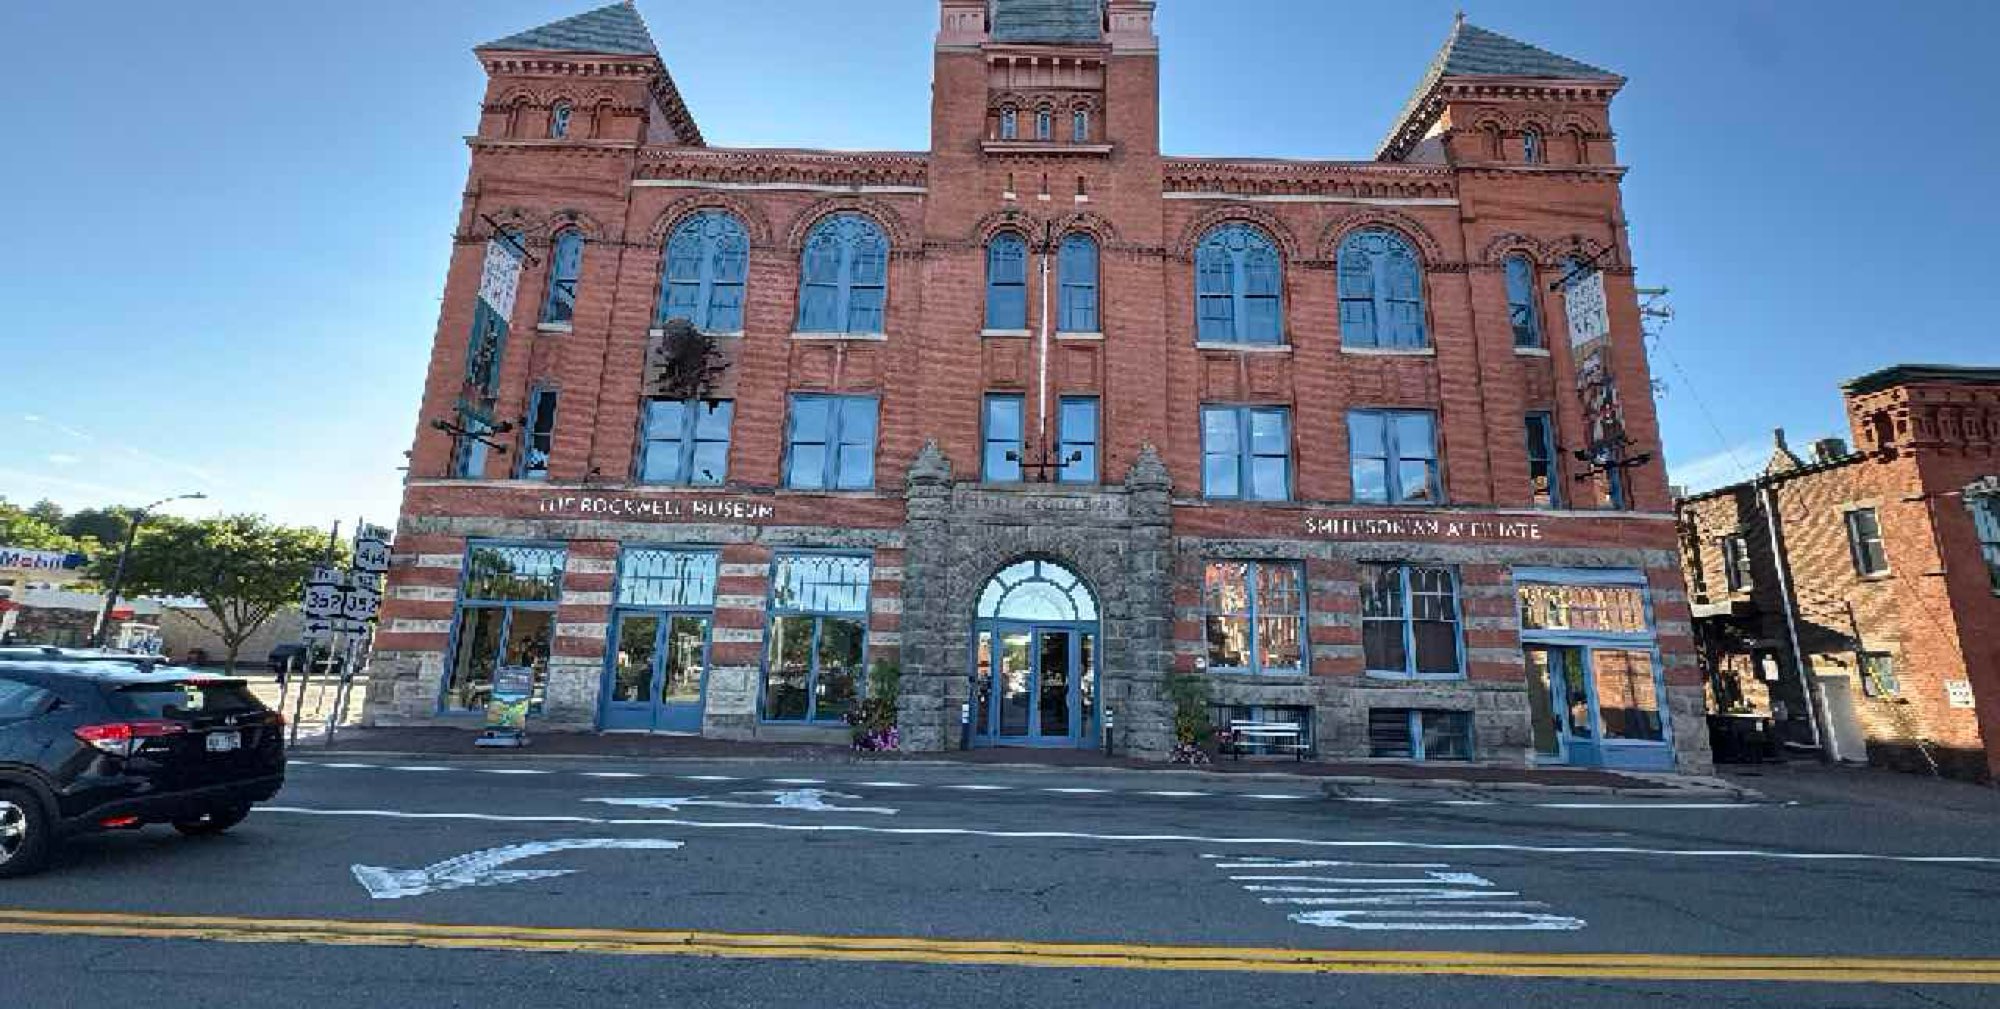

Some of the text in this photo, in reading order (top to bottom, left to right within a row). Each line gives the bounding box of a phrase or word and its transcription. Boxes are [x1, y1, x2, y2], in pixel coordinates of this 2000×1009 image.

[538, 497, 773, 518] THE ROCKWELL MUSEUM
[1305, 516, 1439, 536] SMITHSONIAN
[0, 550, 63, 569] Mobil
[308, 591, 341, 609] 352
[347, 596, 376, 613] 352
